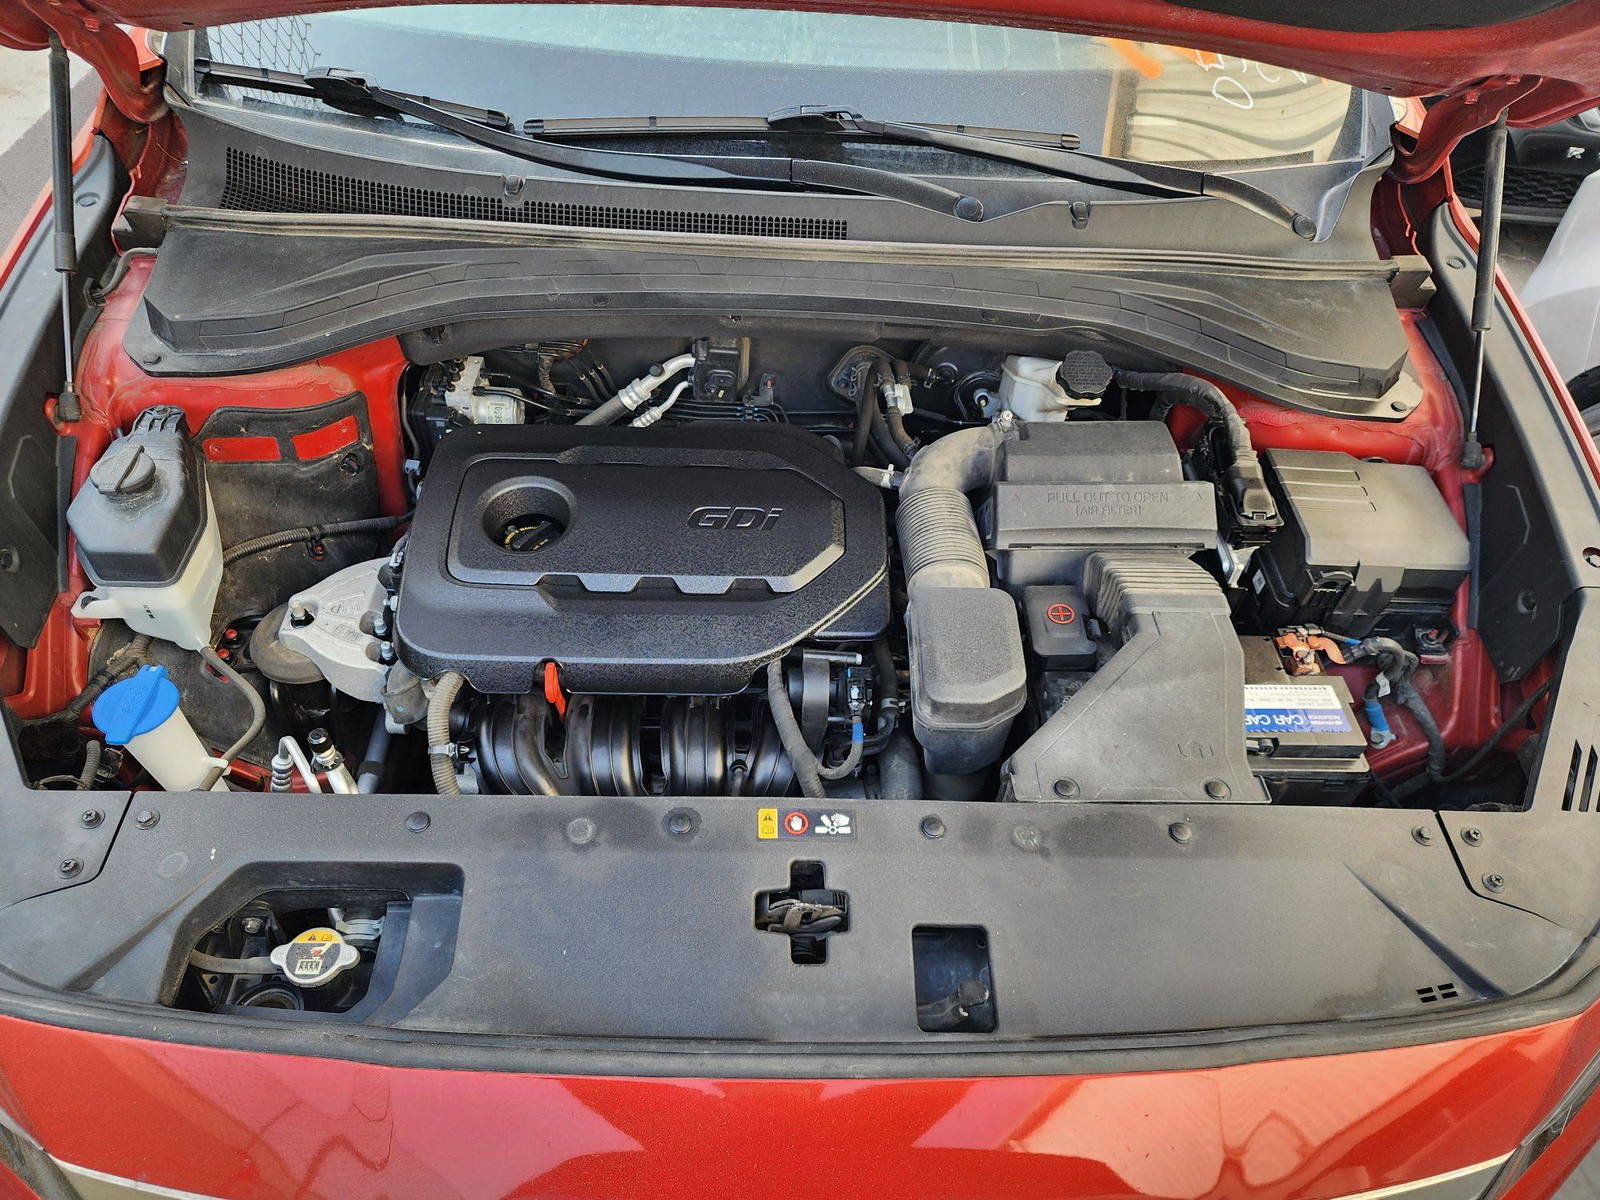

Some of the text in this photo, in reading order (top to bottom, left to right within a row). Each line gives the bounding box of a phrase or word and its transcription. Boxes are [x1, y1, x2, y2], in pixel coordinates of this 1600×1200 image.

[1047, 491, 1170, 503] PULL OUT TO OPEN
[687, 506, 783, 530] GDi
[1272, 714, 1305, 726] CAR
